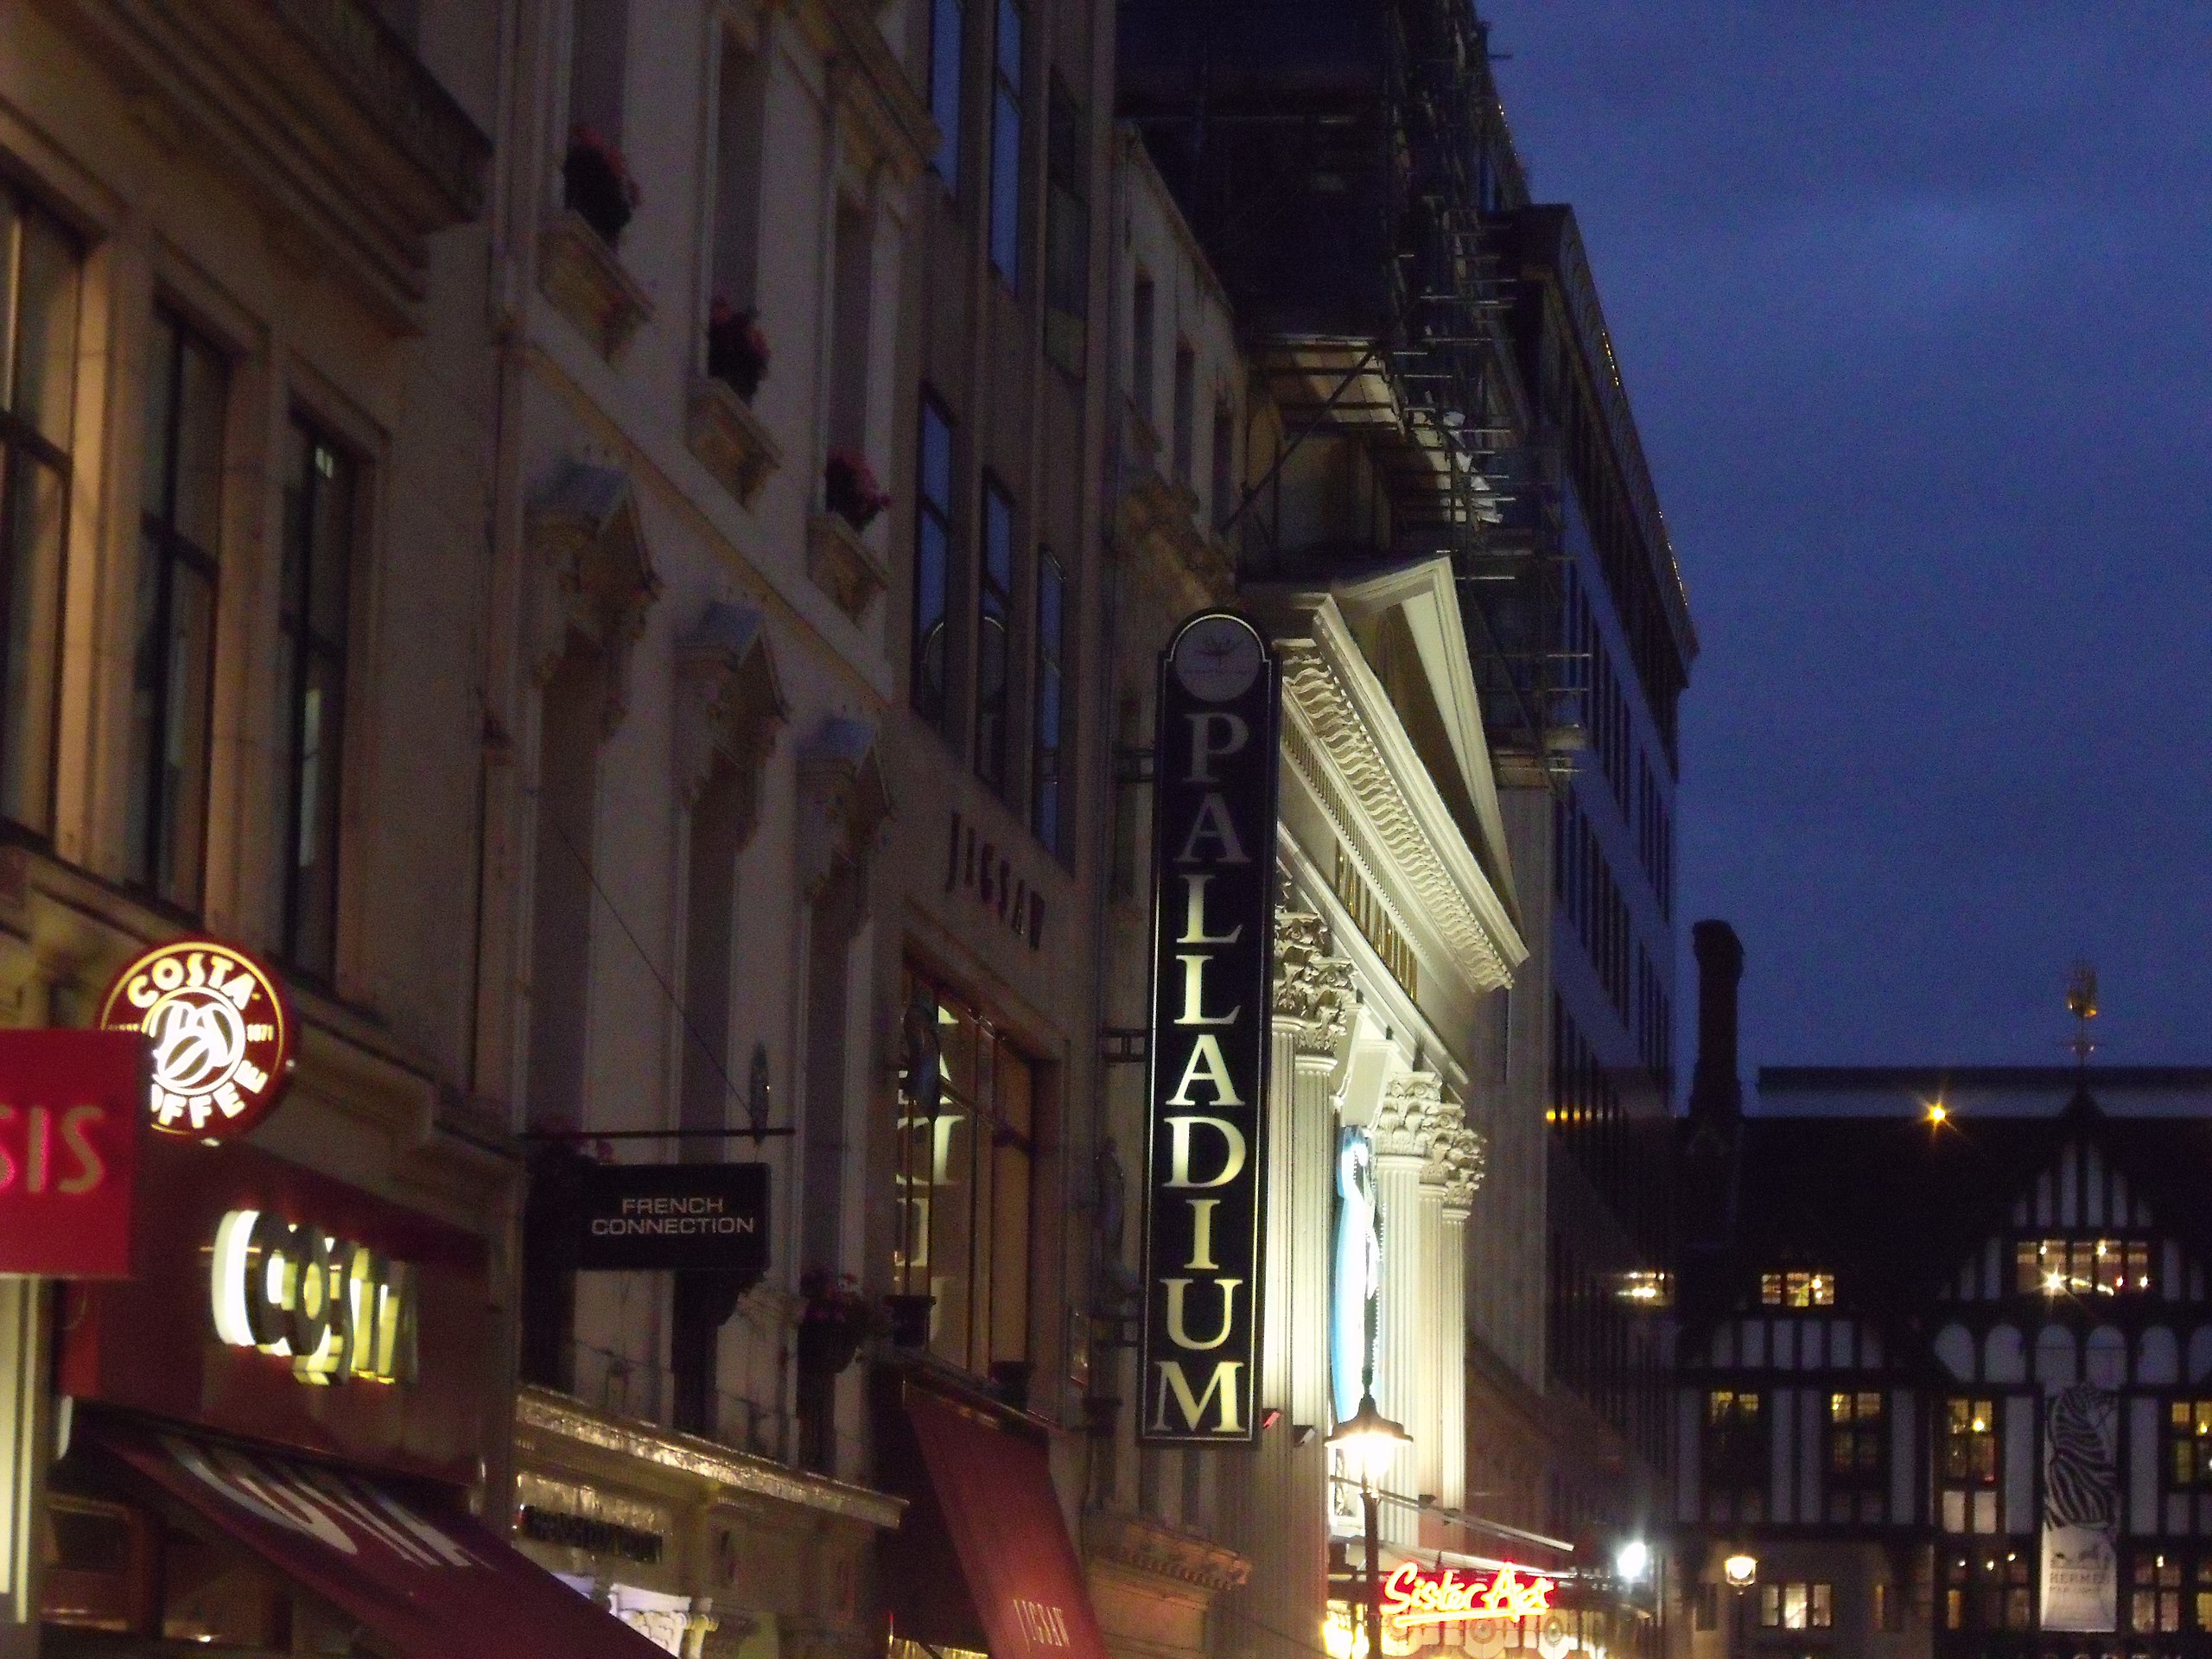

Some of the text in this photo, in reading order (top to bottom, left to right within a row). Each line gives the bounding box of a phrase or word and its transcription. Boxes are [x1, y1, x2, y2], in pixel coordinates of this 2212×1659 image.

[127, 952, 257, 1010] COSTA
[1152, 712, 1252, 1433] PALLADIUM
[591, 1217, 754, 1236] CONNECTION
[622, 1197, 724, 1215] FRENCH
[1380, 1561, 1488, 1614] Sister
